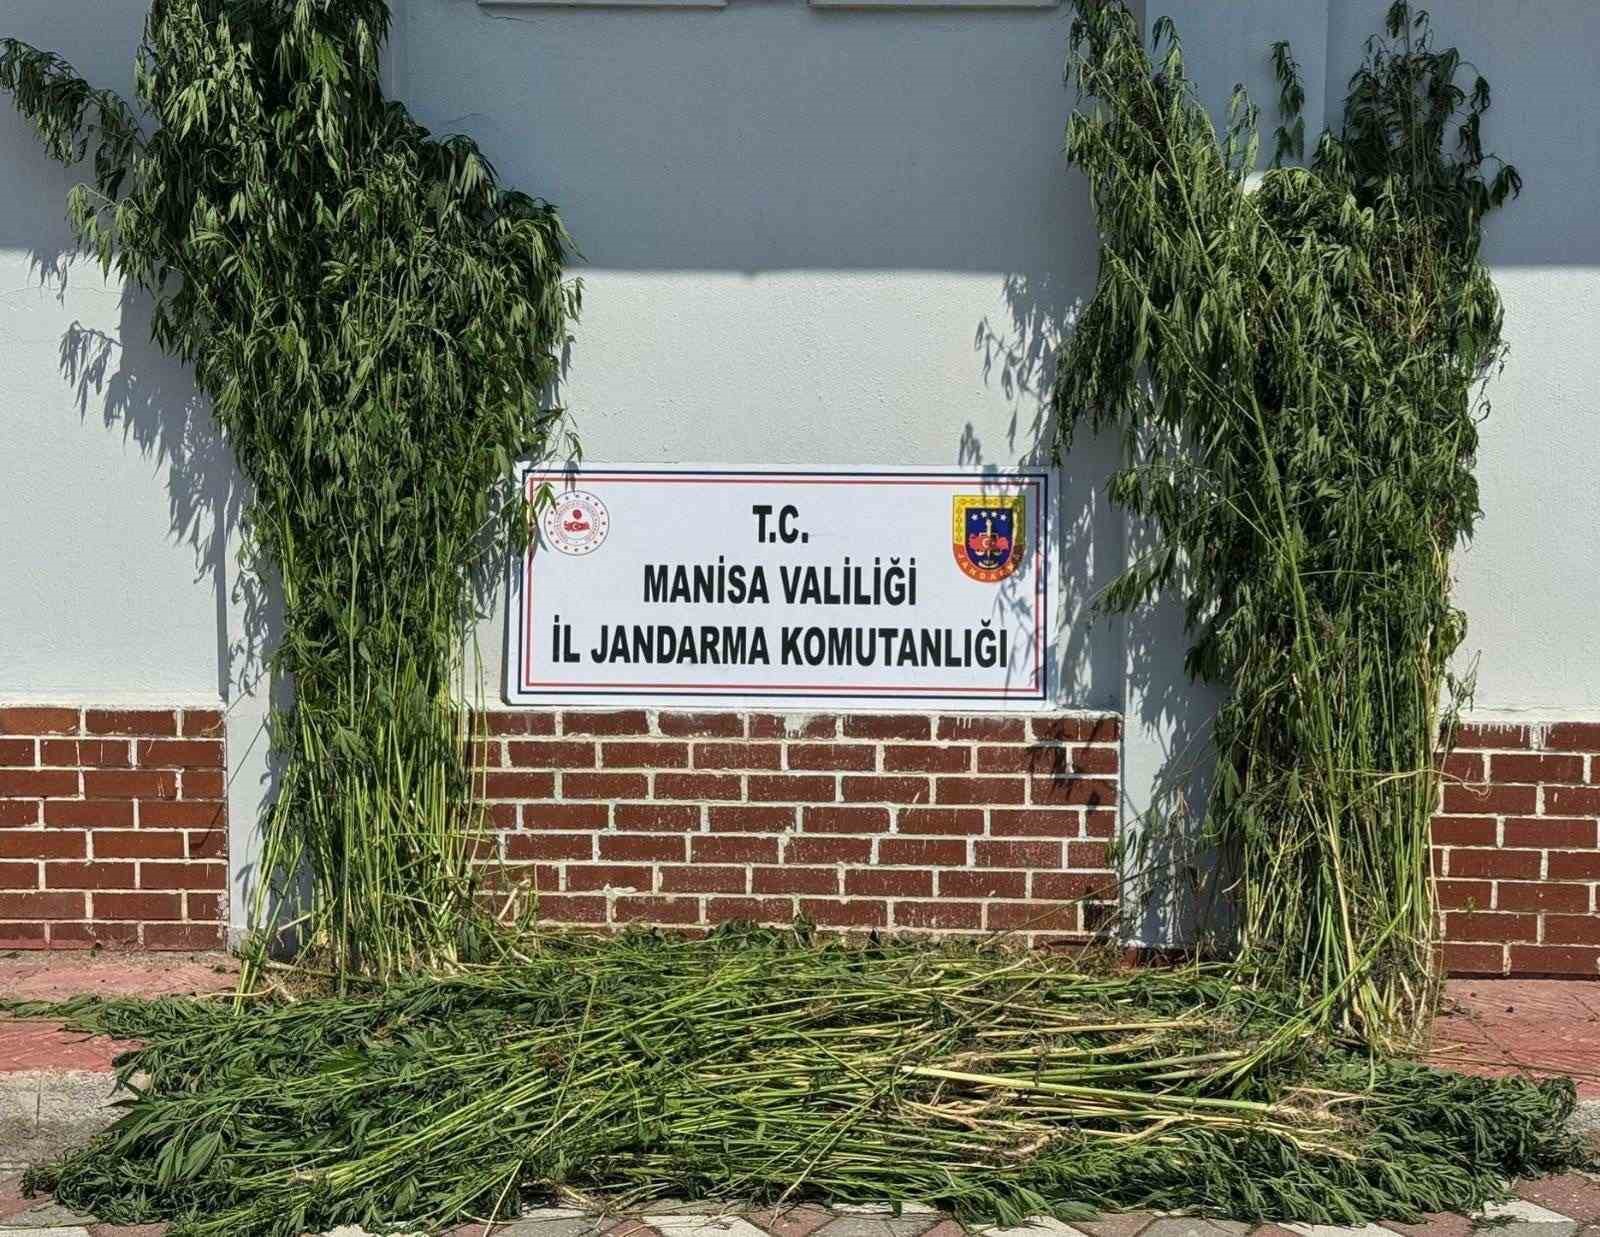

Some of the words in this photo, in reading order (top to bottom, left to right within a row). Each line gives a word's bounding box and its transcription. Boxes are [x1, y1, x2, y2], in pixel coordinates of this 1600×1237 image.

[753, 504, 809, 544] T.C.
[644, 556, 769, 604] MANİSA
[780, 557, 917, 605] VALİLİĞİ
[552, 614, 581, 663] İL
[591, 624, 770, 665] JANDARMA
[782, 619, 1008, 668] KOMUTANLIĞI
